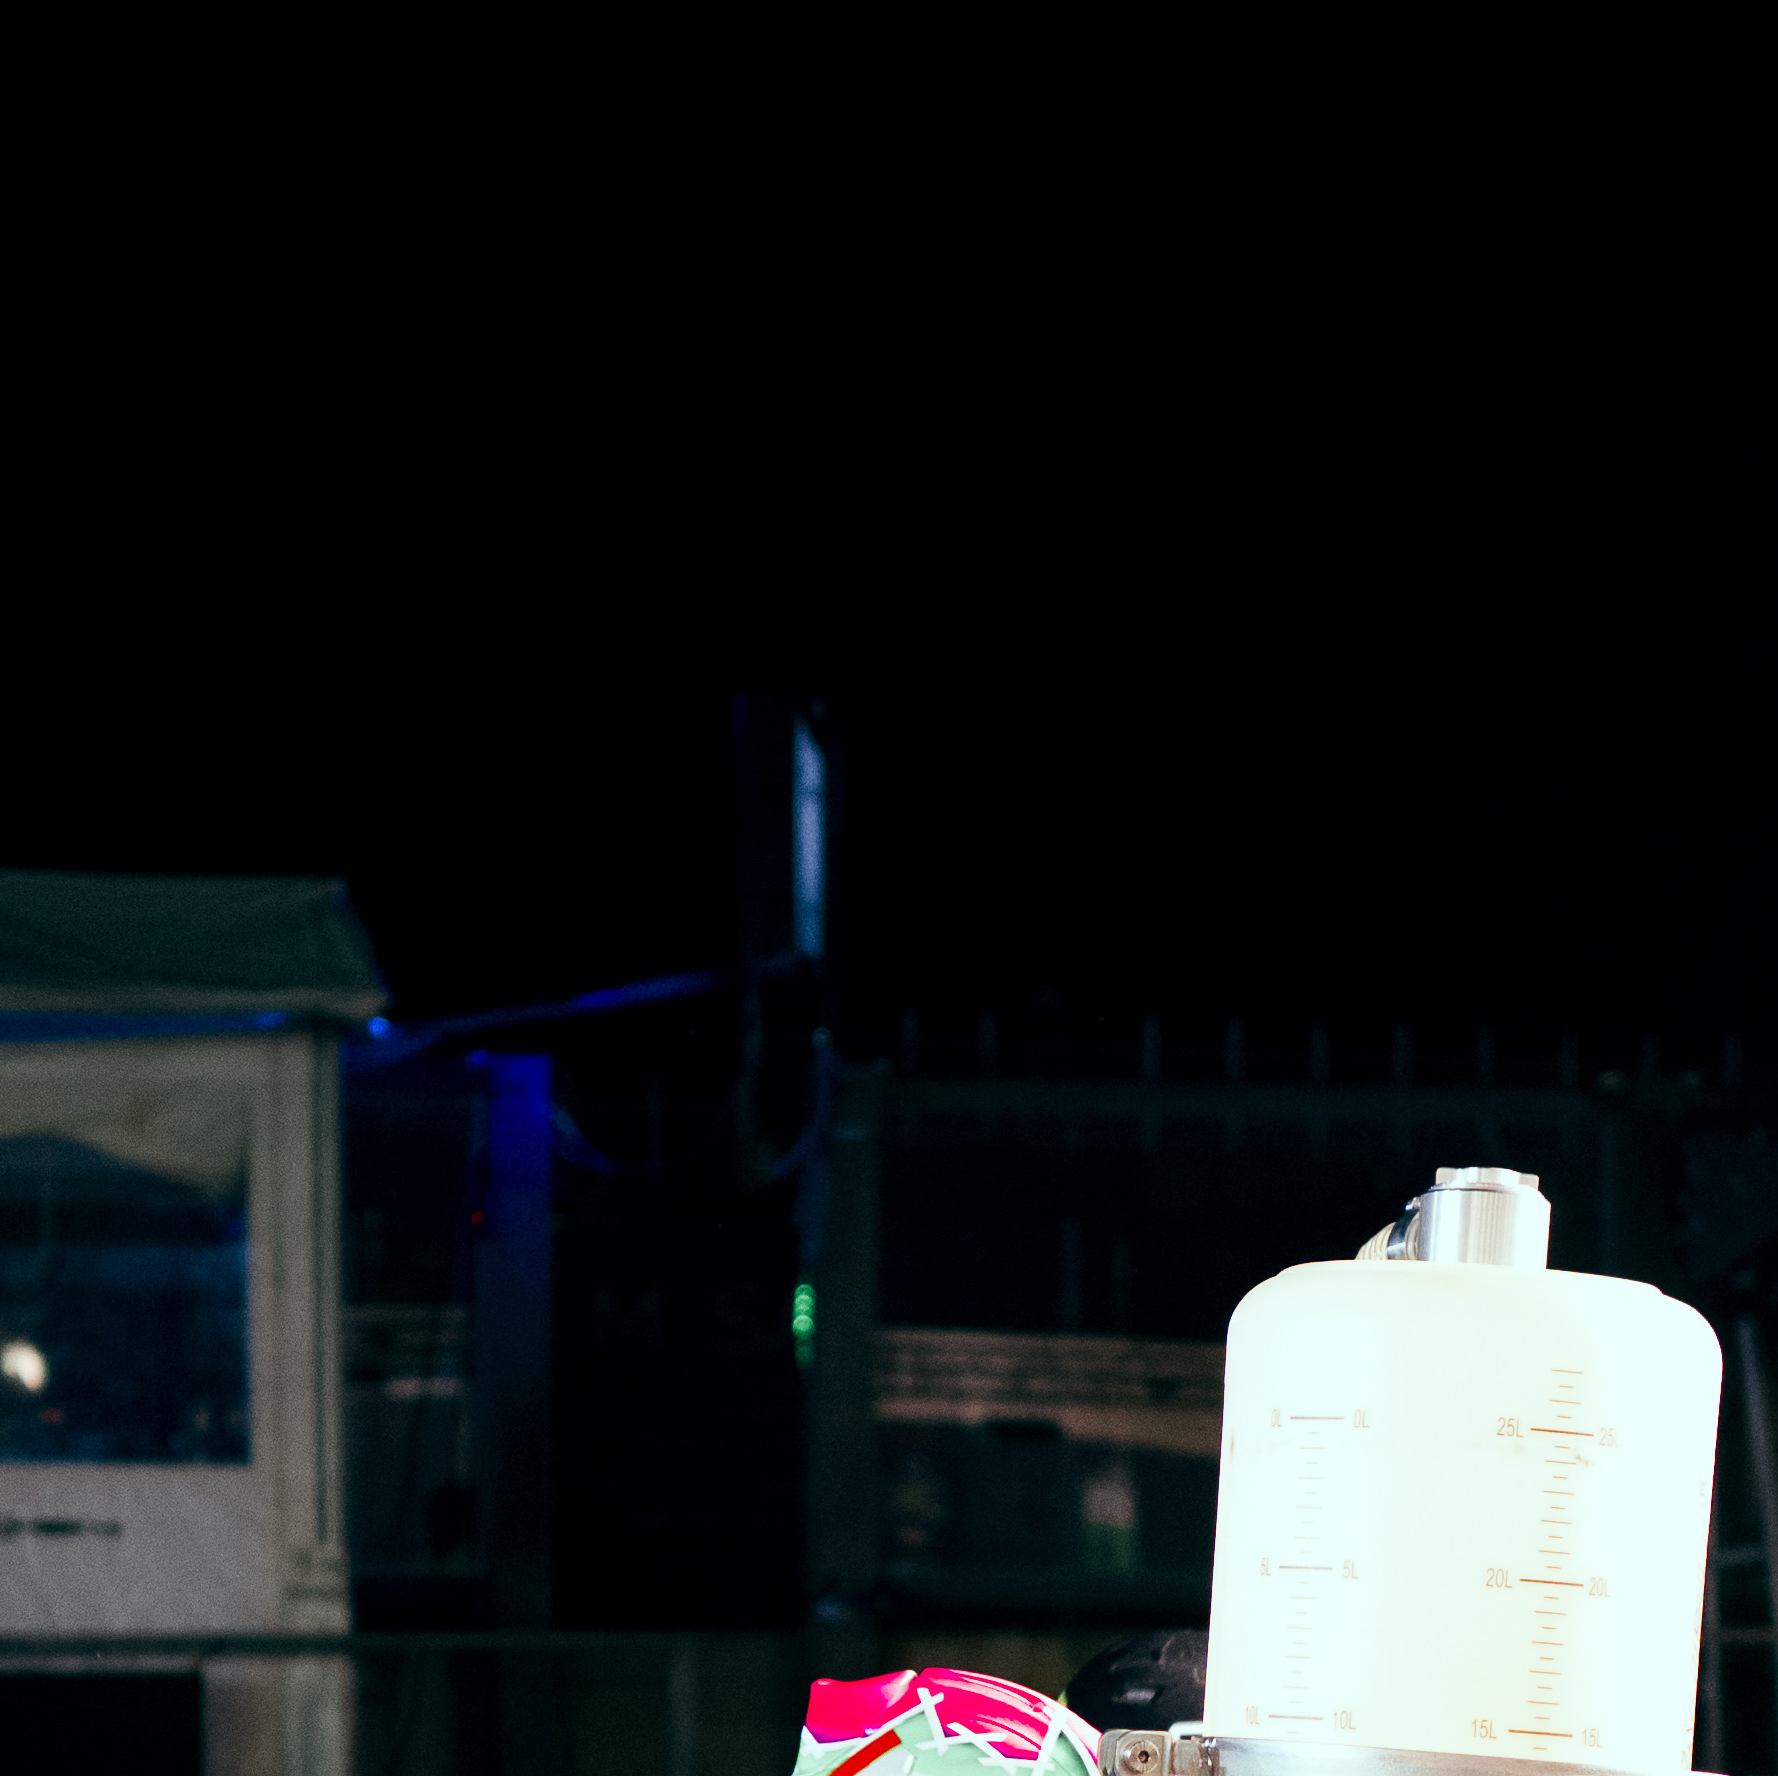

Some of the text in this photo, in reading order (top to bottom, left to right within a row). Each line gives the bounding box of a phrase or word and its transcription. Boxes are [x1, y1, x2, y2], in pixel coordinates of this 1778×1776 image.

[1497, 1418, 1523, 1437] 25L
[1599, 1428, 1620, 1446] 25L
[1342, 1560, 1358, 1578] 5L
[1486, 1568, 1512, 1588] 20L
[1589, 1577, 1610, 1597] 20L
[1333, 1711, 1356, 1729] 10L
[1472, 1719, 1497, 1739] 15L
[1582, 1729, 1602, 1748] 15L
